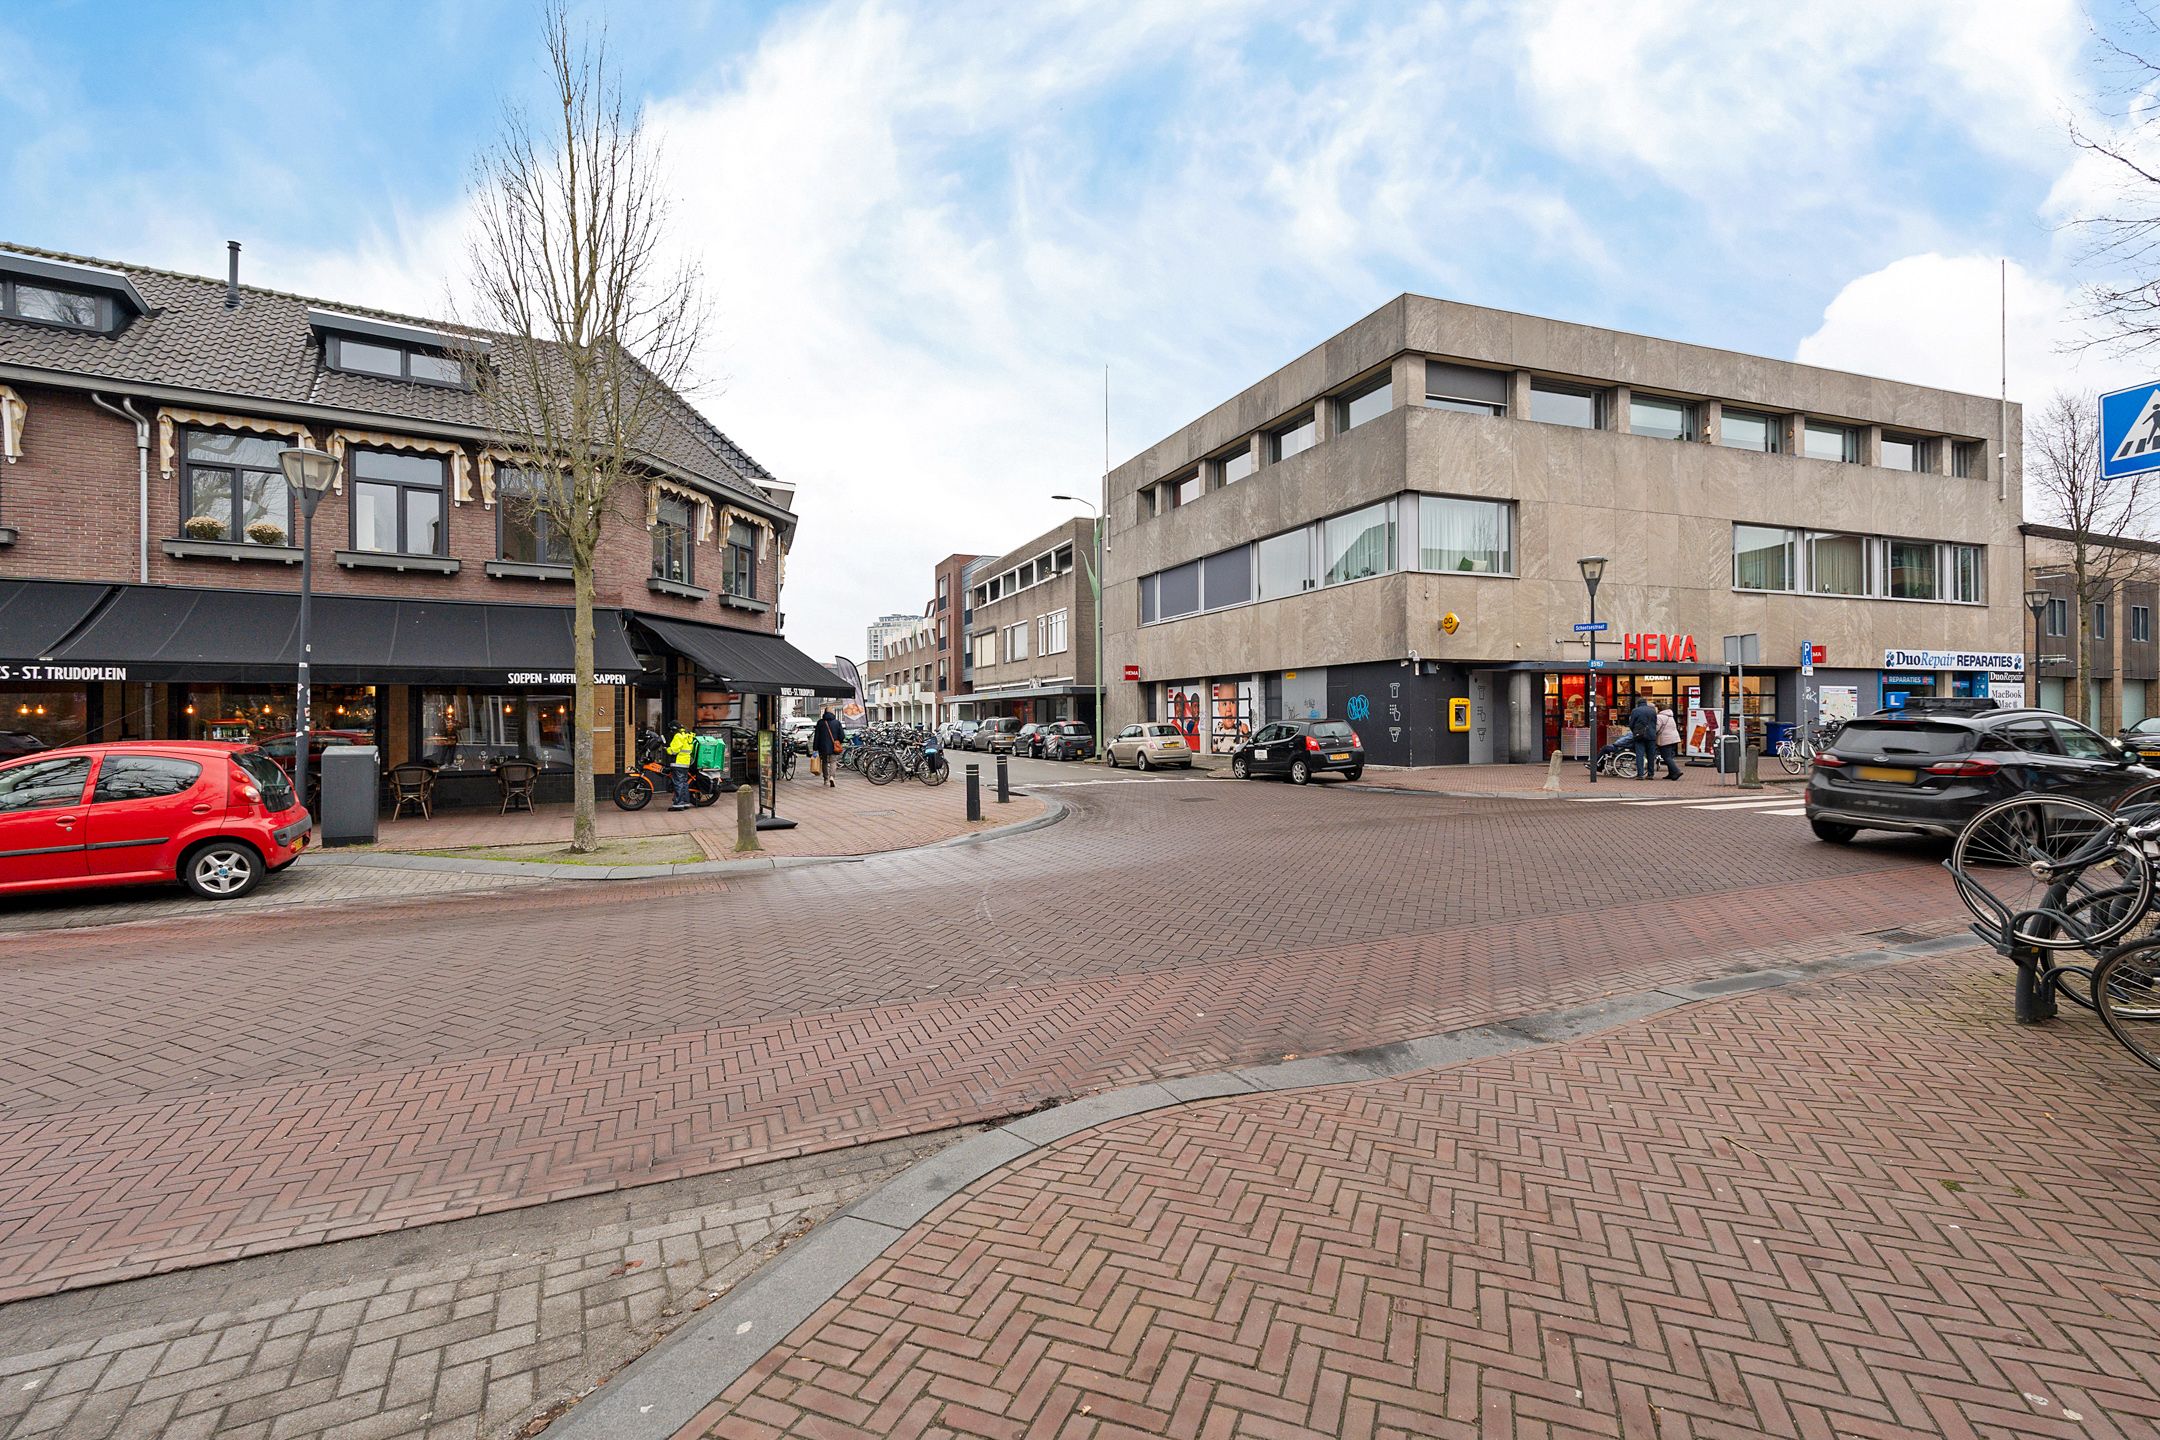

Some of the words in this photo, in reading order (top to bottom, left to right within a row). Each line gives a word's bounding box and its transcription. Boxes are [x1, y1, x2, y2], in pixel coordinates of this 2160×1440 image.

[1624, 633, 1698, 662] HEMA
[1805, 643, 1810, 656] P
[1896, 651, 1955, 668] DuoRepair
[1956, 655, 2013, 667] REPARATIES
[22, 666, 42, 680] ST.
[44, 667, 127, 681] TRUDOPLEIN
[507, 673, 543, 684] SOEPEN
[593, 674, 626, 685] SAPPEN
[1991, 672, 2024, 682] DuoRepair
[1890, 694, 1901, 706] L
[1991, 689, 2022, 699] MacBook
